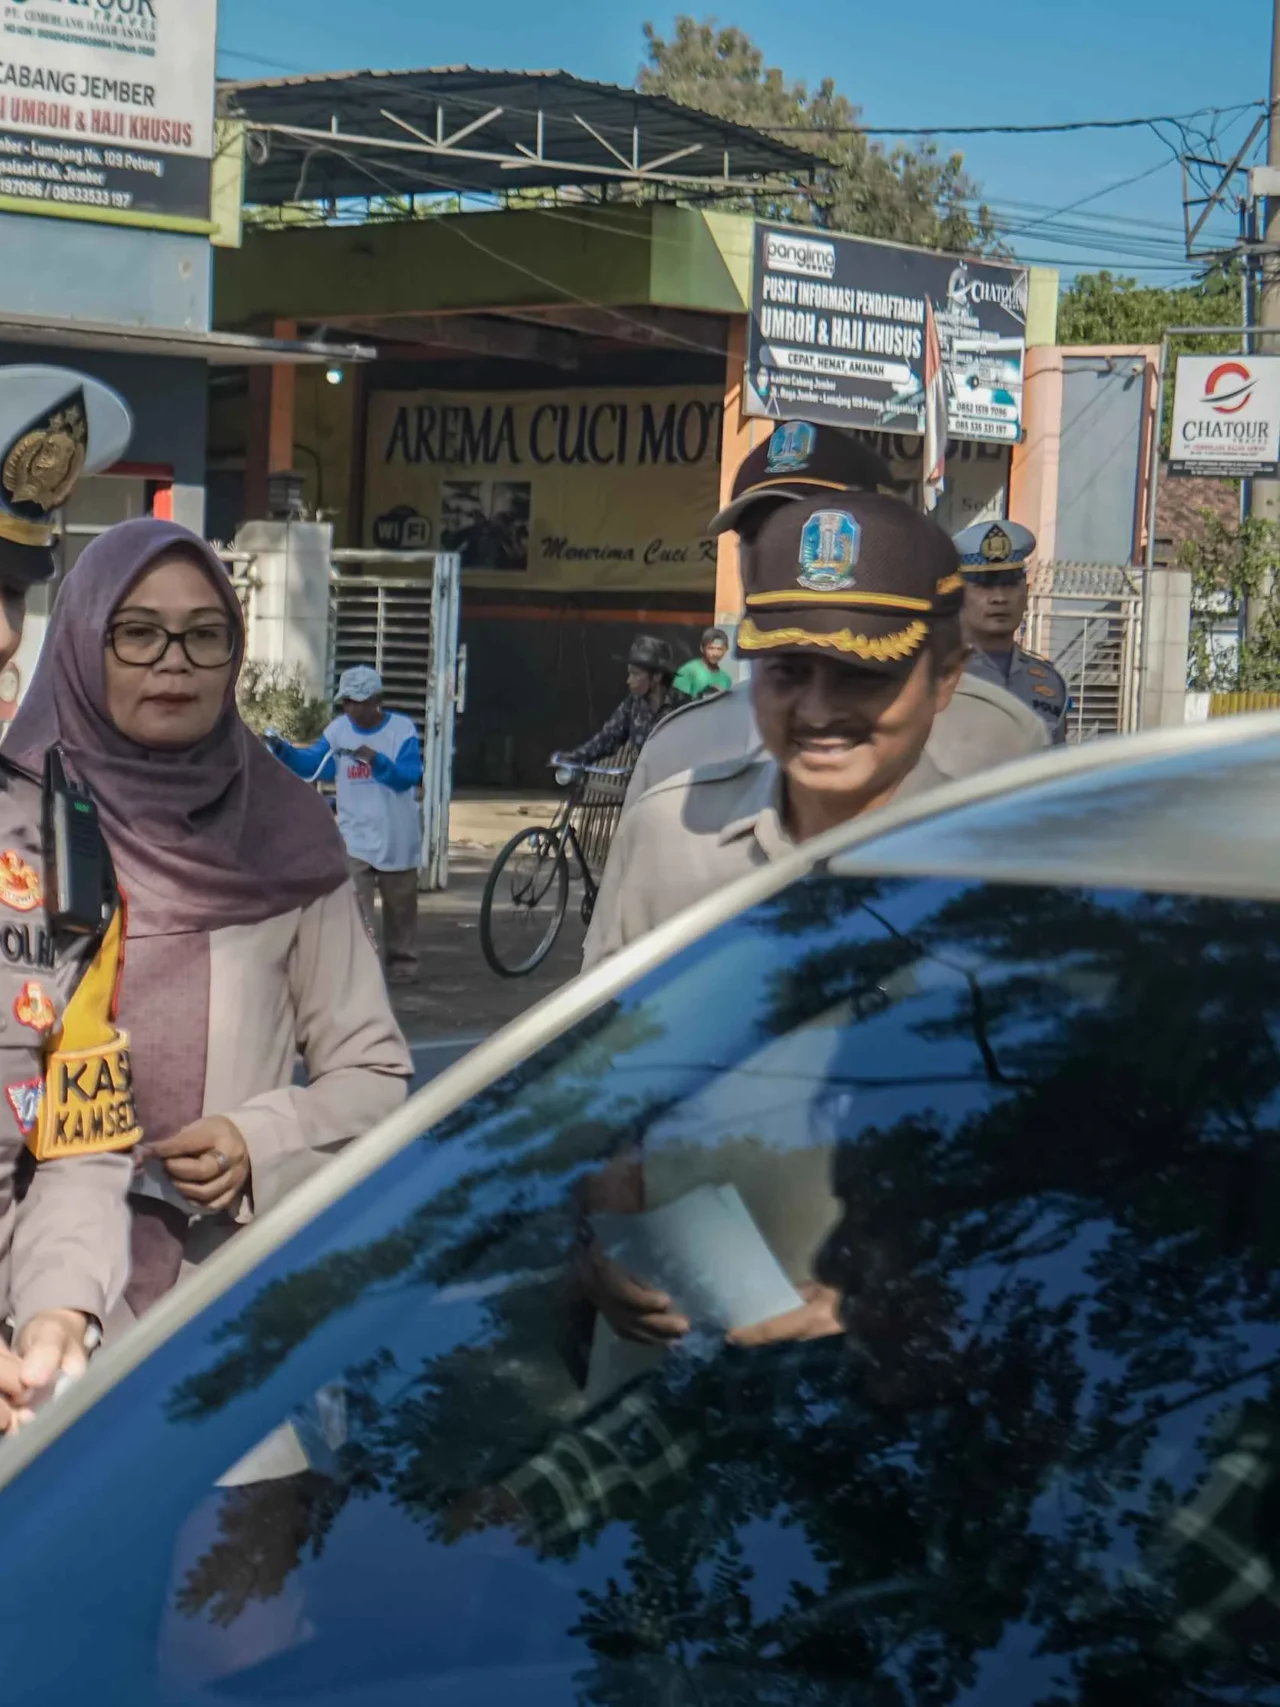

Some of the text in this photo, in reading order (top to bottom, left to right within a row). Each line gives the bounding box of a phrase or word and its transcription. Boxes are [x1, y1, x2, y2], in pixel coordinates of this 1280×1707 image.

[93, 8, 156, 31] TRAVEL
[80, 74, 156, 107] JEMBER
[11, 97, 70, 130] UMROH
[75, 111, 85, 132] &
[91, 108, 124, 138] HAJI
[129, 115, 192, 147] KHUSUS
[31, 140, 83, 167] Lumajang
[84, 148, 102, 165] No.
[104, 150, 123, 169] 109
[124, 153, 163, 177] Petung
[63, 165, 105, 186] Jember
[763, 274, 797, 304] PUSAT
[798, 281, 854, 313] INFORMASI
[856, 289, 924, 324] PENDAFTARAN
[760, 305, 816, 344] UMROH
[817, 317, 830, 346] &
[831, 316, 863, 350] HAJI
[865, 320, 922, 359] KHUSUS
[788, 352, 884, 377] CEPAT, HEMAT, AMANAH
[384, 404, 521, 465] AREMA
[529, 402, 628, 465] CUCI
[1182, 420, 1269, 441] CHATOUR
[541, 536, 634, 561] Menerima
[643, 538, 688, 565] Cuci
